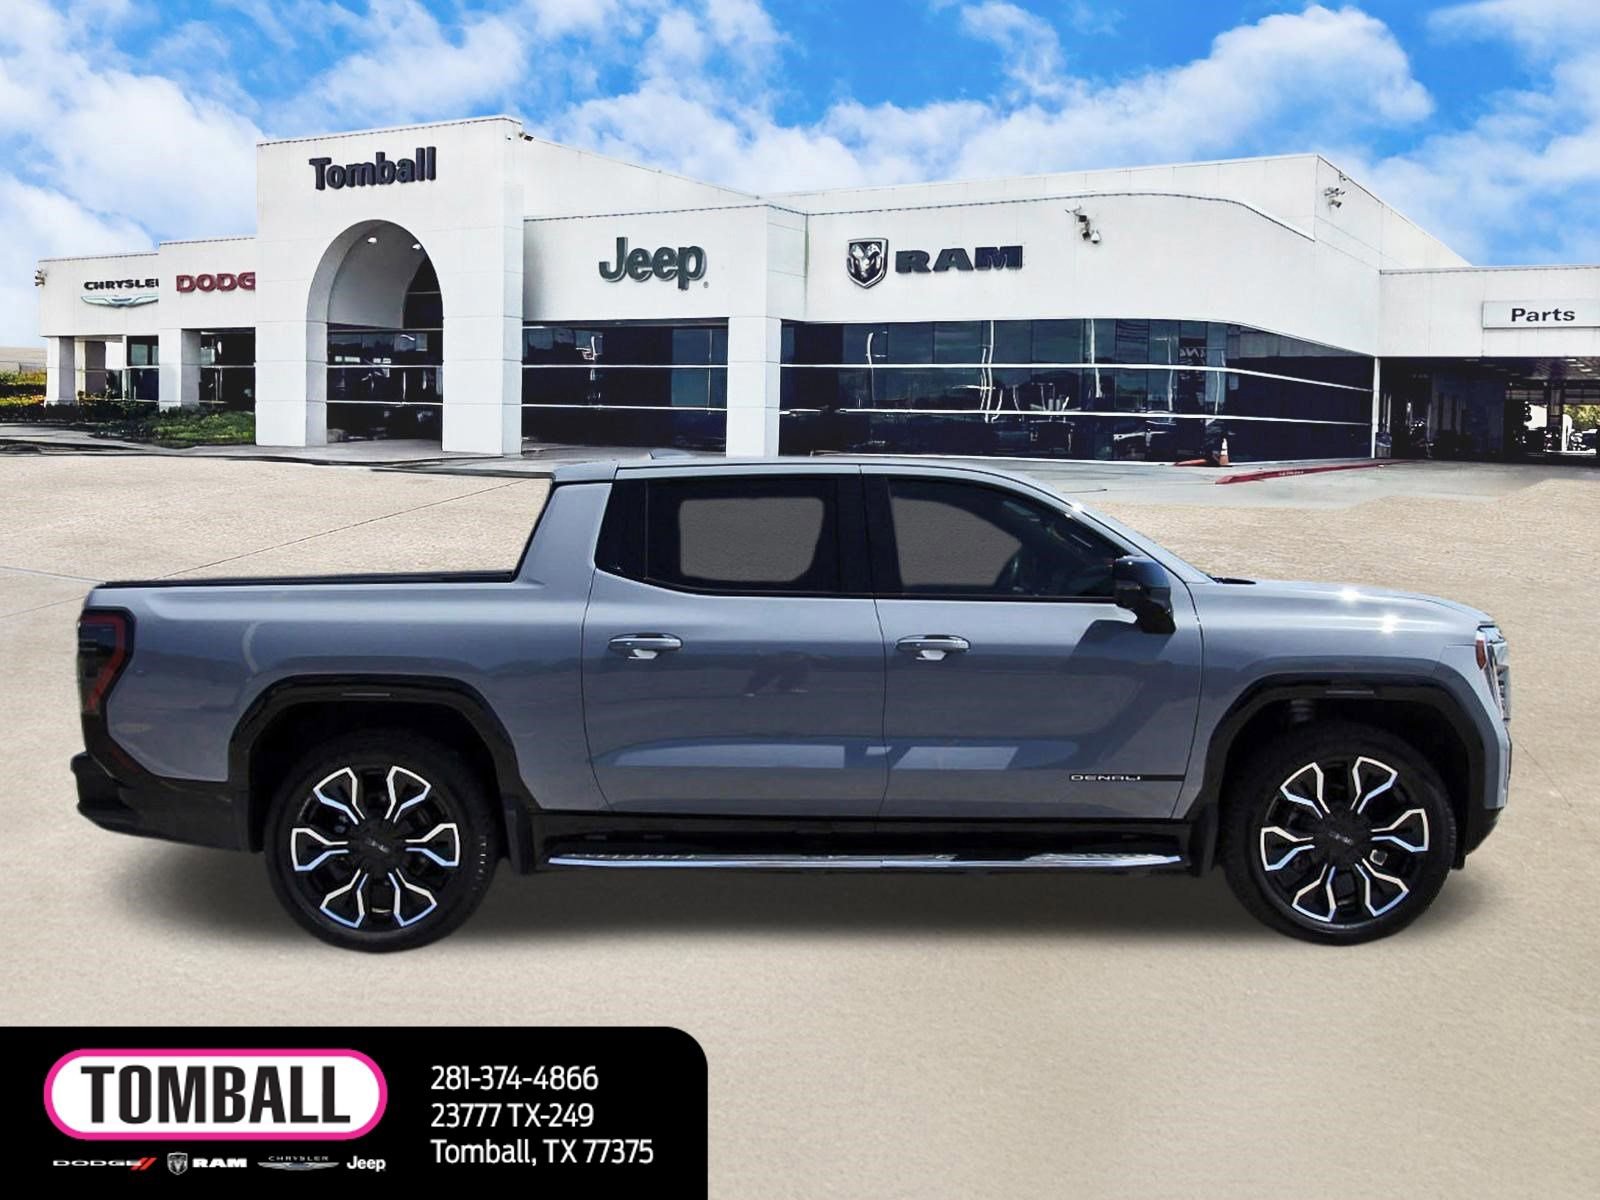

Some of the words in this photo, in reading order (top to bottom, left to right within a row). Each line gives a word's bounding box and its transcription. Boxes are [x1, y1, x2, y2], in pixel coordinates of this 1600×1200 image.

[308, 146, 437, 191] Tomball
[598, 237, 707, 290] Jeep
[895, 245, 1023, 274] RAM
[83, 278, 159, 291] CHRYSLE
[1511, 307, 1576, 322] Parts
[1070, 773, 1142, 782] DENALI
